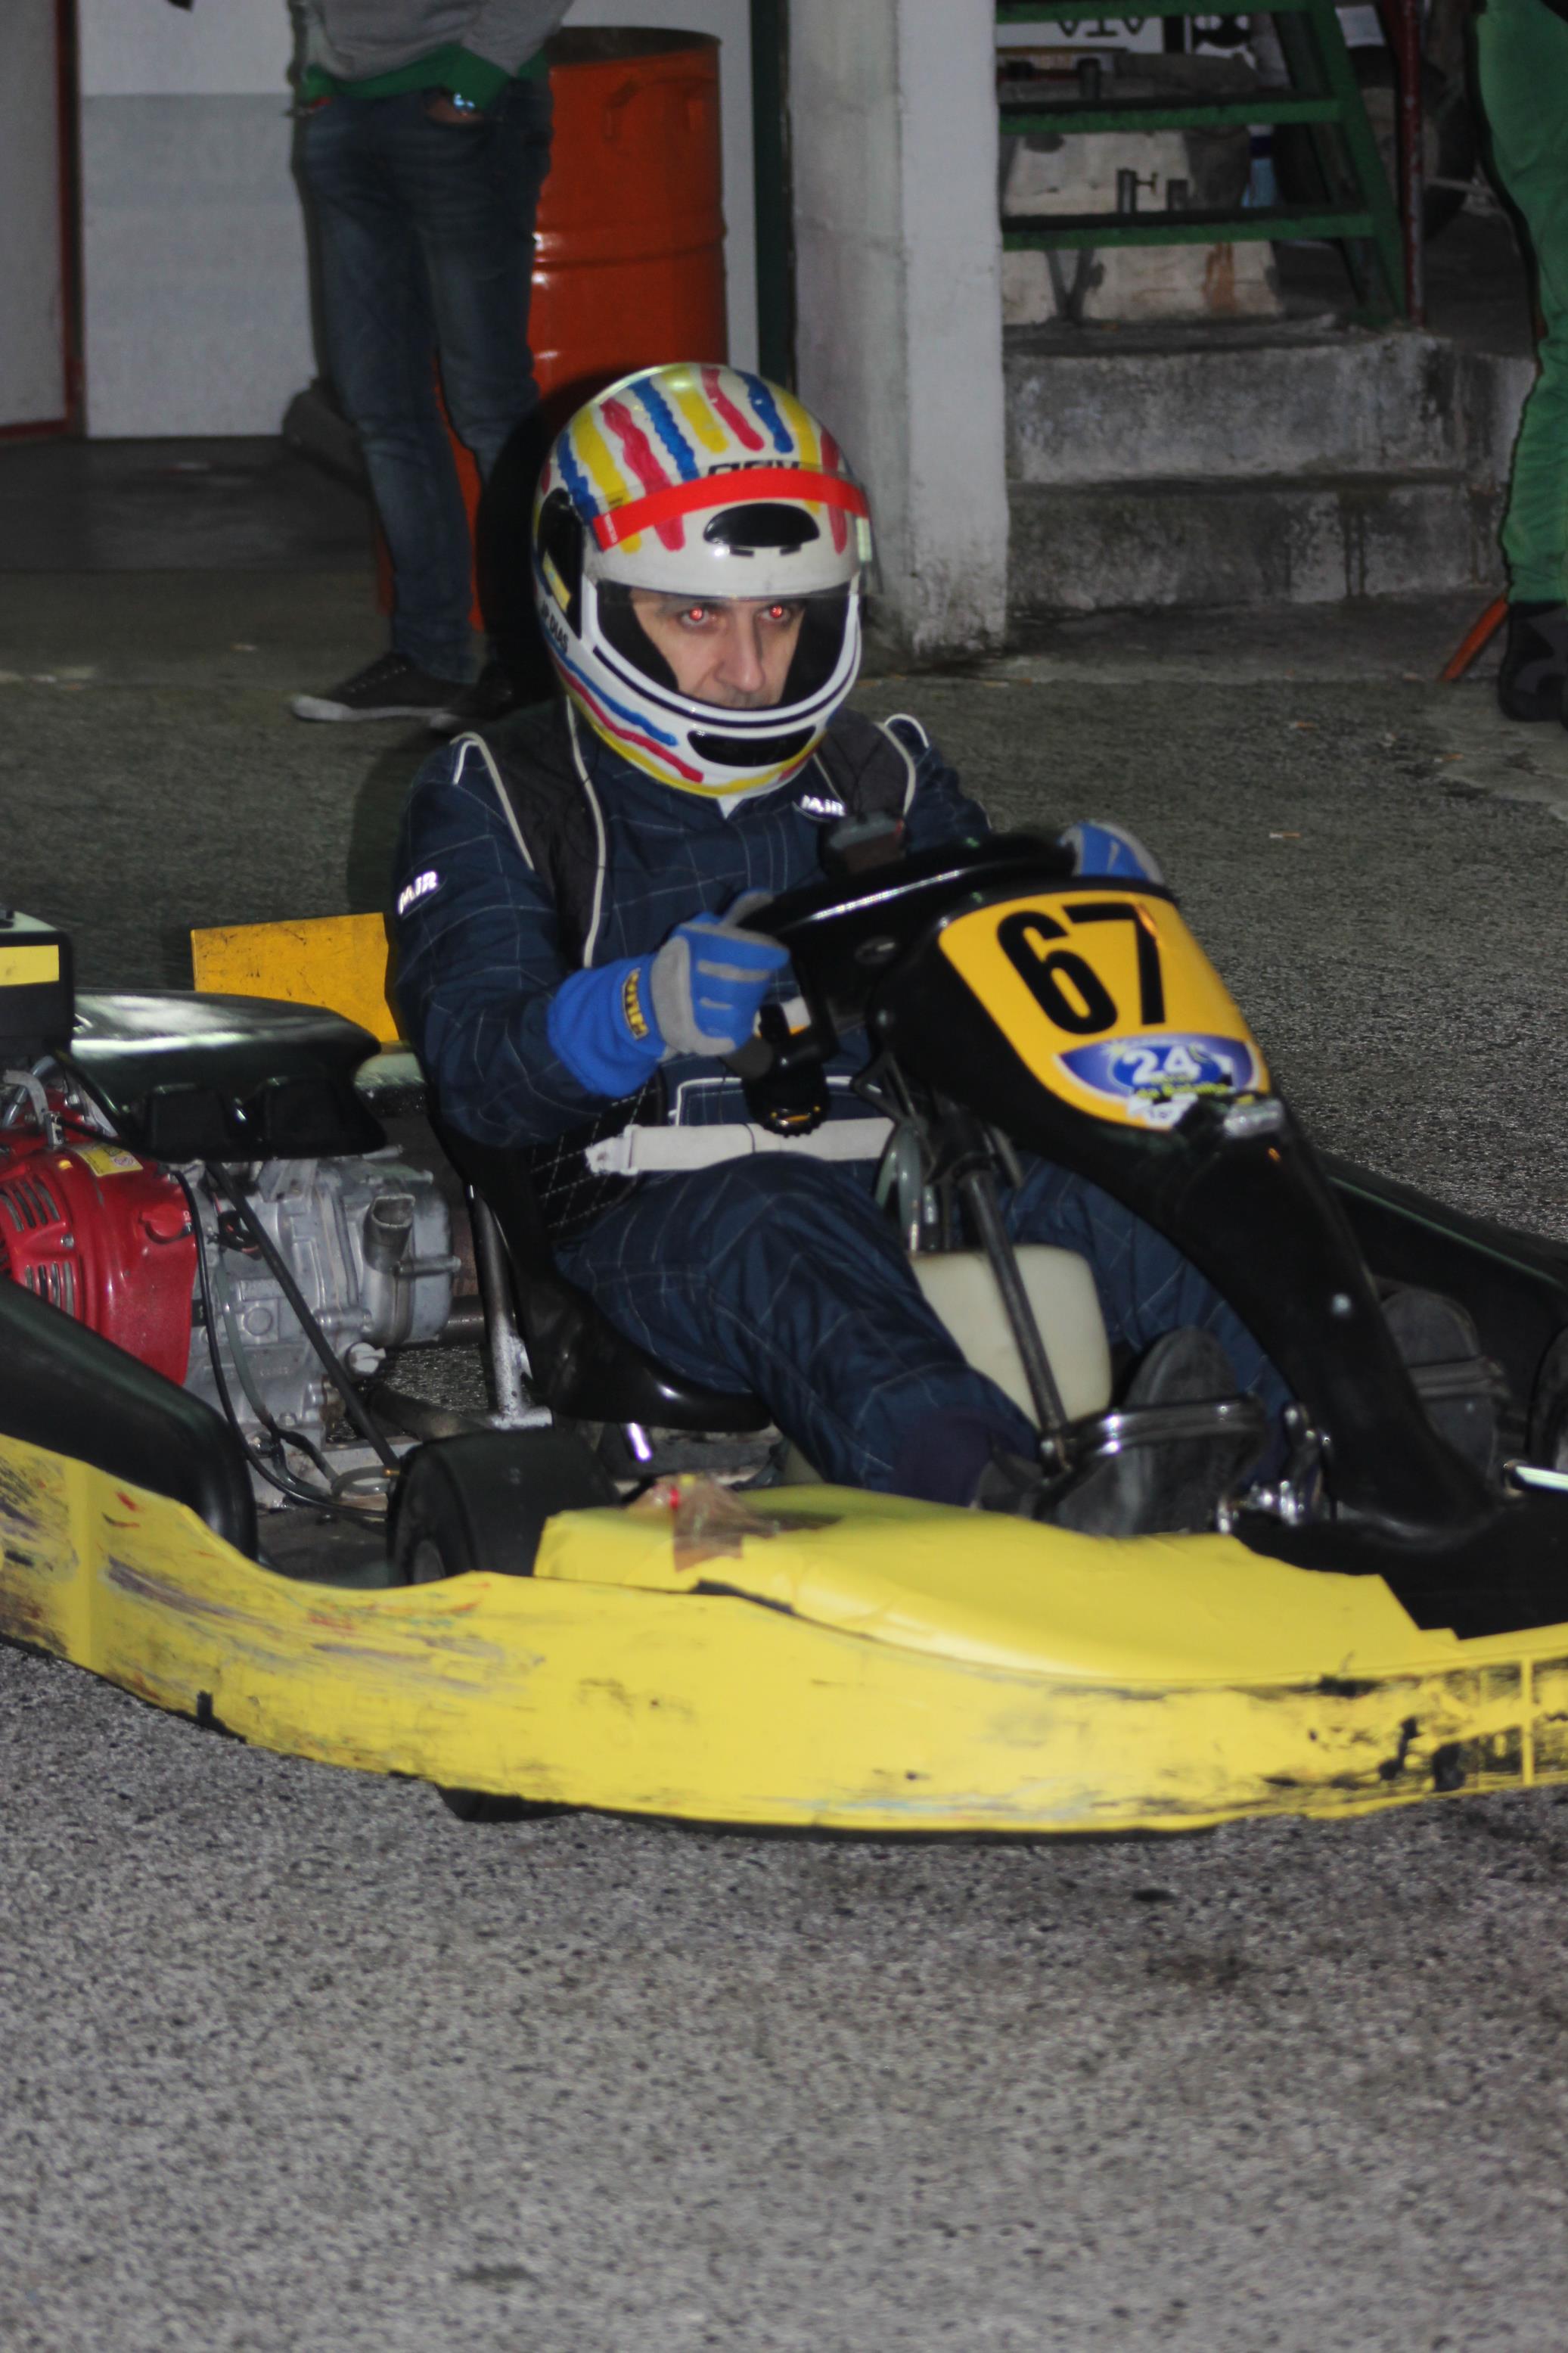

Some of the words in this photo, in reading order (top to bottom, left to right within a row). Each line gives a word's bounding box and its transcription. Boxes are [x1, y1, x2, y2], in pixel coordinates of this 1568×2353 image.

[398, 870, 438, 915] MIR
[996, 902, 1166, 1035] 67
[1122, 1044, 1201, 1085] 24
